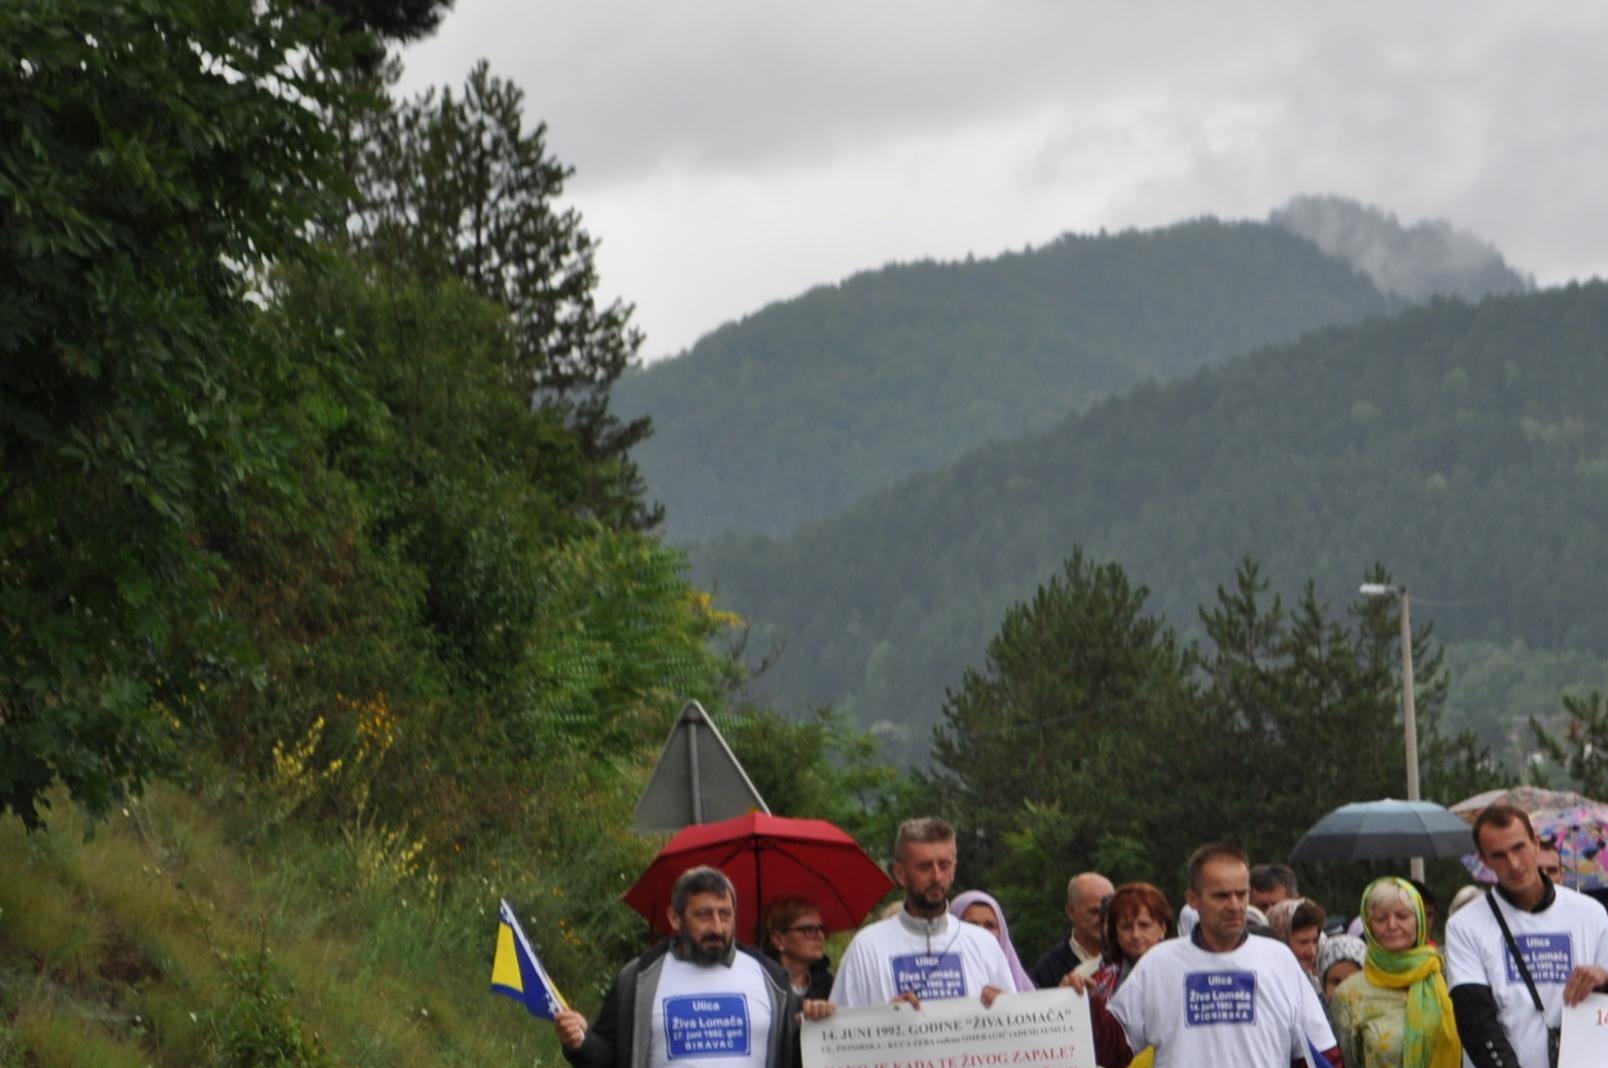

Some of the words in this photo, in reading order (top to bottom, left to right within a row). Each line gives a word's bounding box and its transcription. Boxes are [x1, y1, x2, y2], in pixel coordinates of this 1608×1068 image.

[1207, 975, 1233, 986] Ulica
[1212, 989, 1252, 1001] Lomača
[692, 1000, 720, 1012] Ulica
[671, 1016, 697, 1031] Živa
[699, 1014, 744, 1029] Lomača
[822, 1028, 838, 1042] 14.
[841, 1026, 872, 1040] JUNI
[876, 1024, 905, 1038] 1992.
[908, 1020, 961, 1036] GODINE
[961, 1051, 1008, 1068] ŽIVOG
[1012, 1045, 1075, 1063] ZAPALE?
